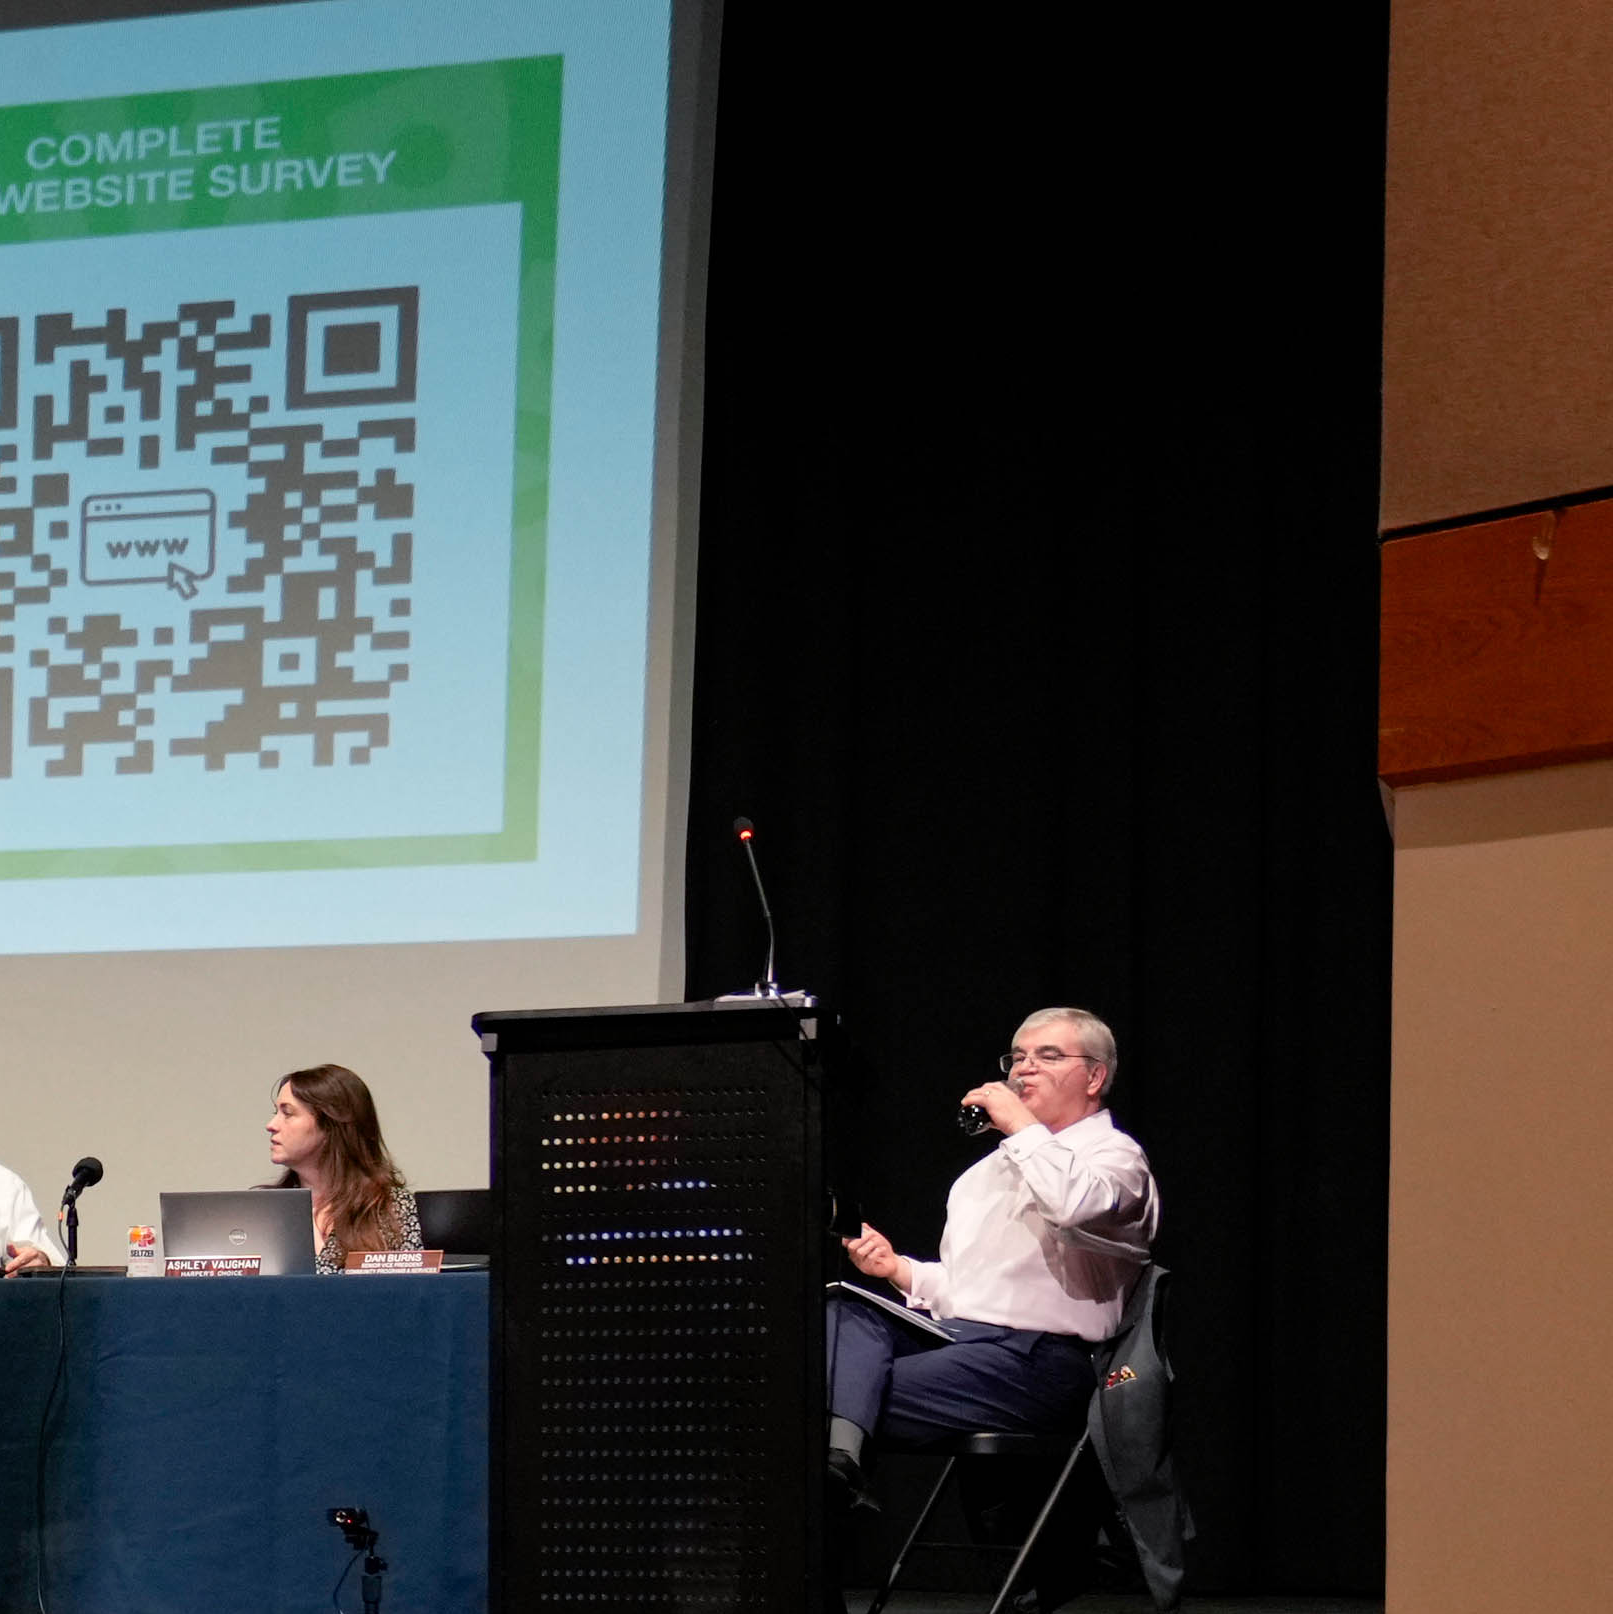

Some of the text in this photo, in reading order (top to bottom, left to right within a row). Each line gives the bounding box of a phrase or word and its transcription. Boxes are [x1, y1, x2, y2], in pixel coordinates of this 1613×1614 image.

[26, 117, 281, 169] COMPLETE
[209, 151, 397, 198] SURVEY
[106, 538, 189, 558] www
[130, 1249, 154, 1257] SELTZER
[364, 1253, 422, 1263] DAN BURNS
[167, 1259, 259, 1270] ASHLEY VAUGHAN
[217, 1269, 244, 1277] CHOICE
